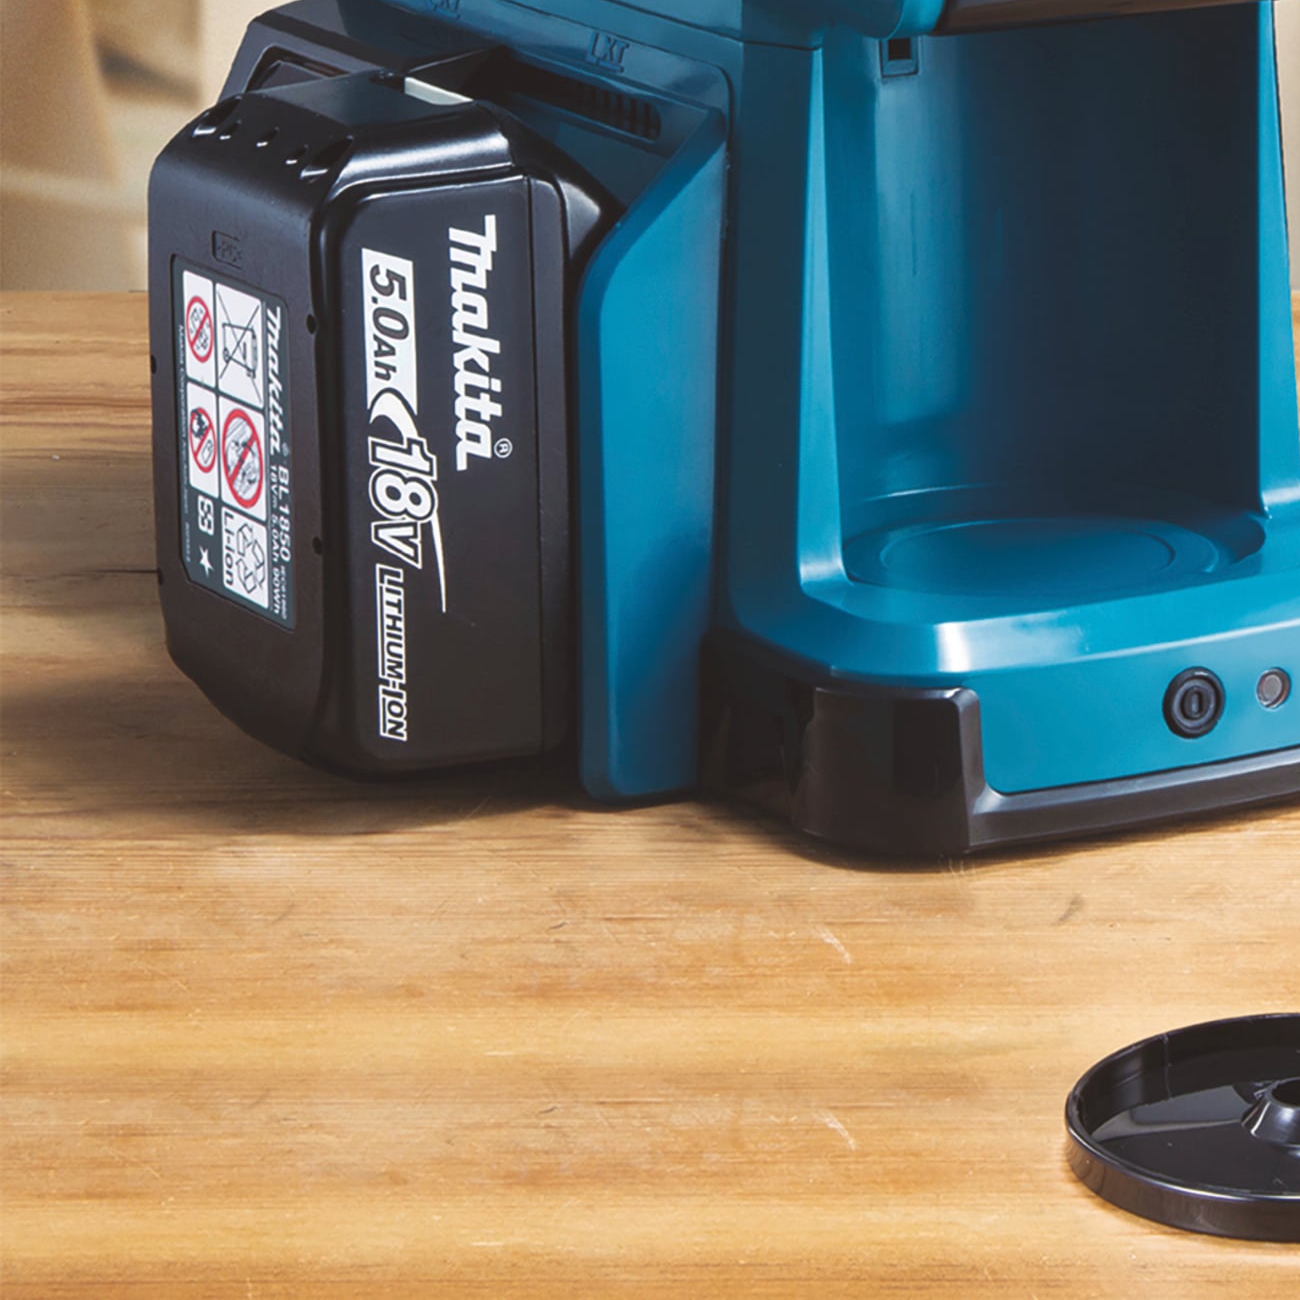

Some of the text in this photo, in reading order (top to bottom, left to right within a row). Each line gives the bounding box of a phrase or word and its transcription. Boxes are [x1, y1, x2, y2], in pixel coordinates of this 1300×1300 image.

[584, 31, 630, 74] LXT
[369, 264, 410, 381] 5.0Ah
[223, 511, 236, 586] Li-ion
[278, 465, 291, 562] BL1850
[375, 563, 408, 741] LITHIUM-ION
